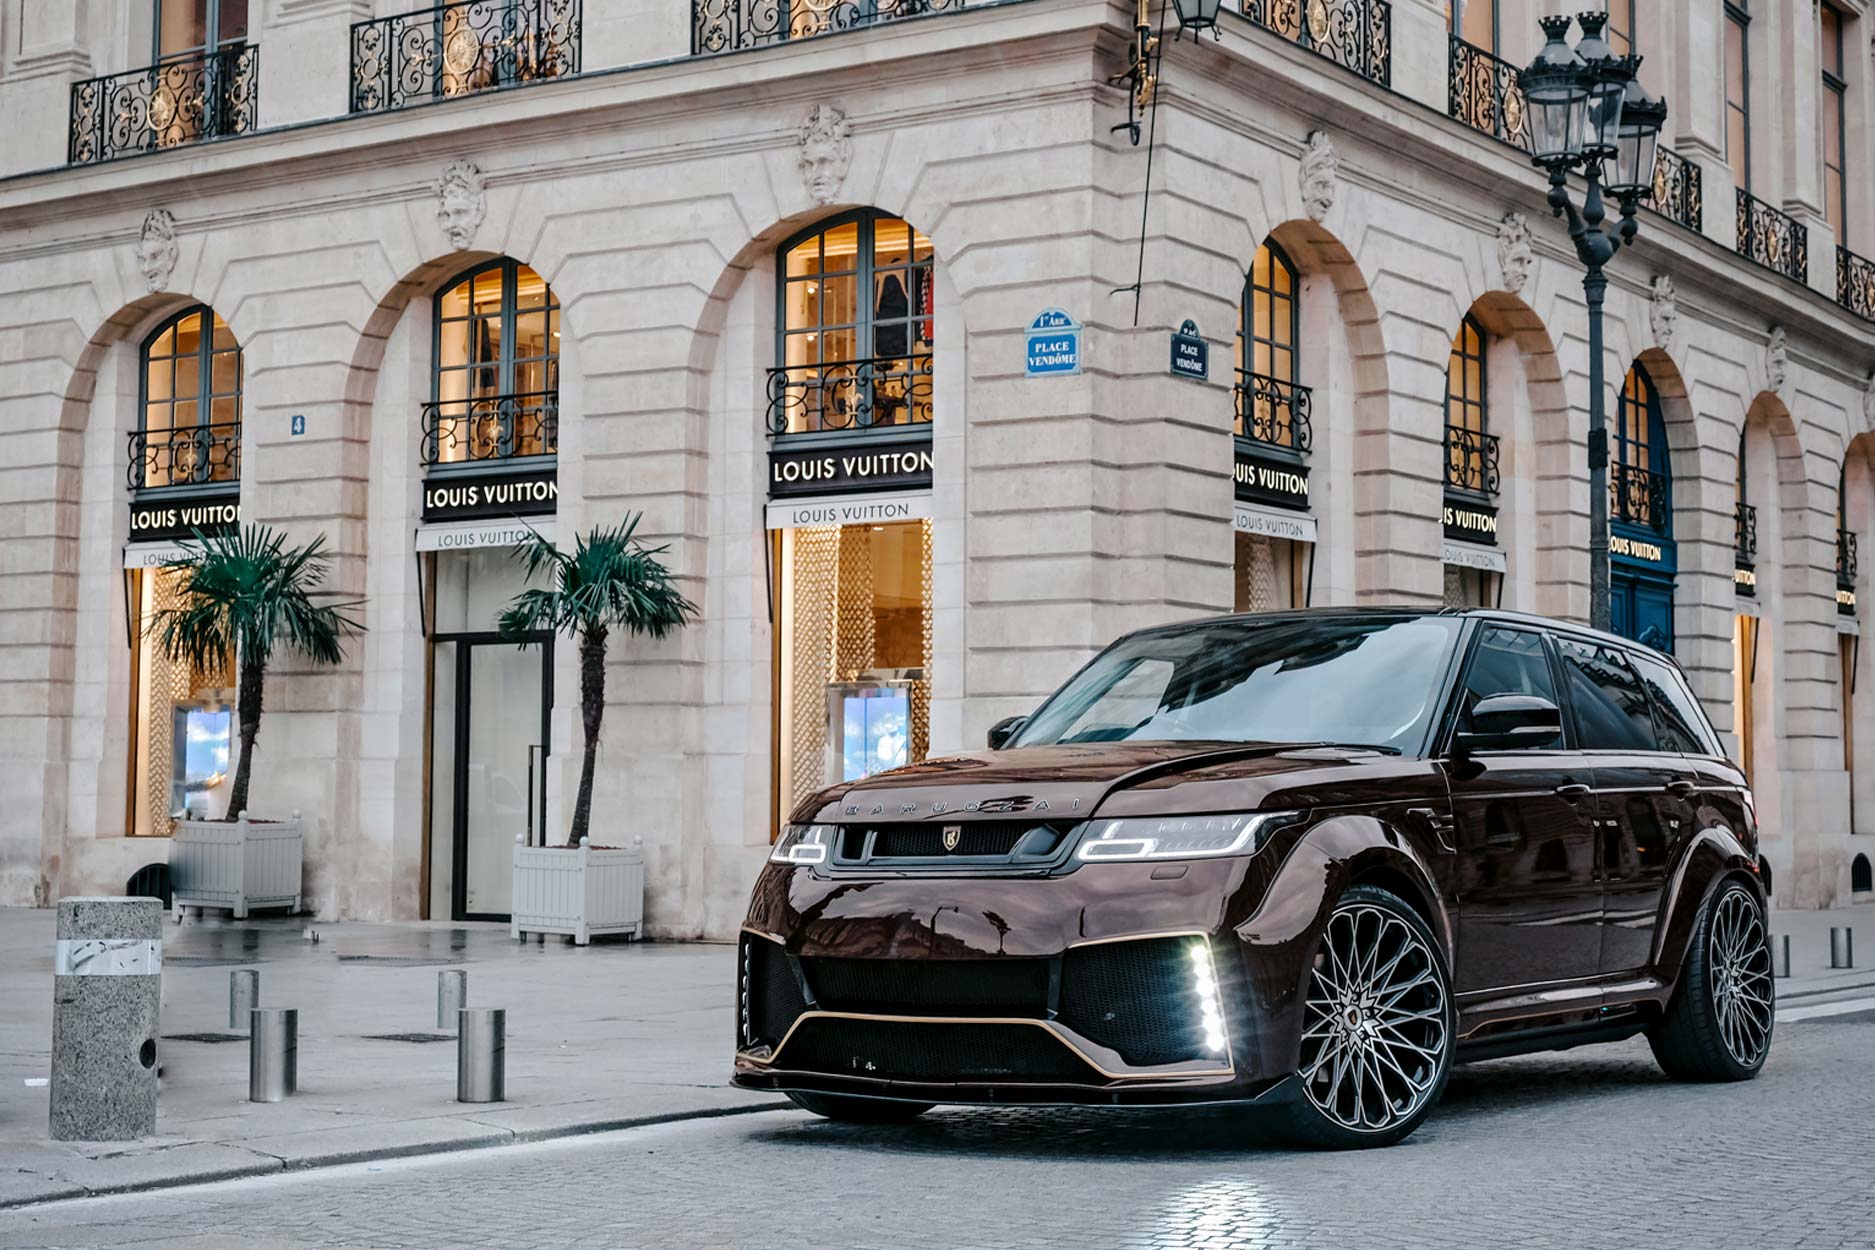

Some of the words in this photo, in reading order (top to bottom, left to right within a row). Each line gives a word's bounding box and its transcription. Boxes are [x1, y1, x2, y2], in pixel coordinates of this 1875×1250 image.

[1035, 341, 1070, 353] PLACE
[1181, 344, 1198, 356] PLACE
[1028, 352, 1077, 366] VENDÔME
[293, 416, 303, 433] 4
[774, 457, 836, 482] LOUIS
[842, 450, 934, 477] VUITTON
[1231, 462, 1256, 485] UIS
[1258, 467, 1308, 495] VUITTON
[426, 486, 478, 508] LOUIS
[484, 480, 558, 504] VUITTON
[131, 509, 176, 530] LOUIS
[793, 508, 836, 524] LOUIS
[842, 503, 909, 520] VUITTON
[1455, 509, 1497, 533] VUITTON
[1236, 514, 1263, 531] LOUIS
[1265, 519, 1304, 536] VUITTON
[438, 533, 475, 547] LOUIS
[479, 529, 530, 545] VUITTO
[1608, 535, 1629, 555] OUIS
[1630, 540, 1661, 561] VUITTON
[845, 798, 1080, 816] BARUGZAI
